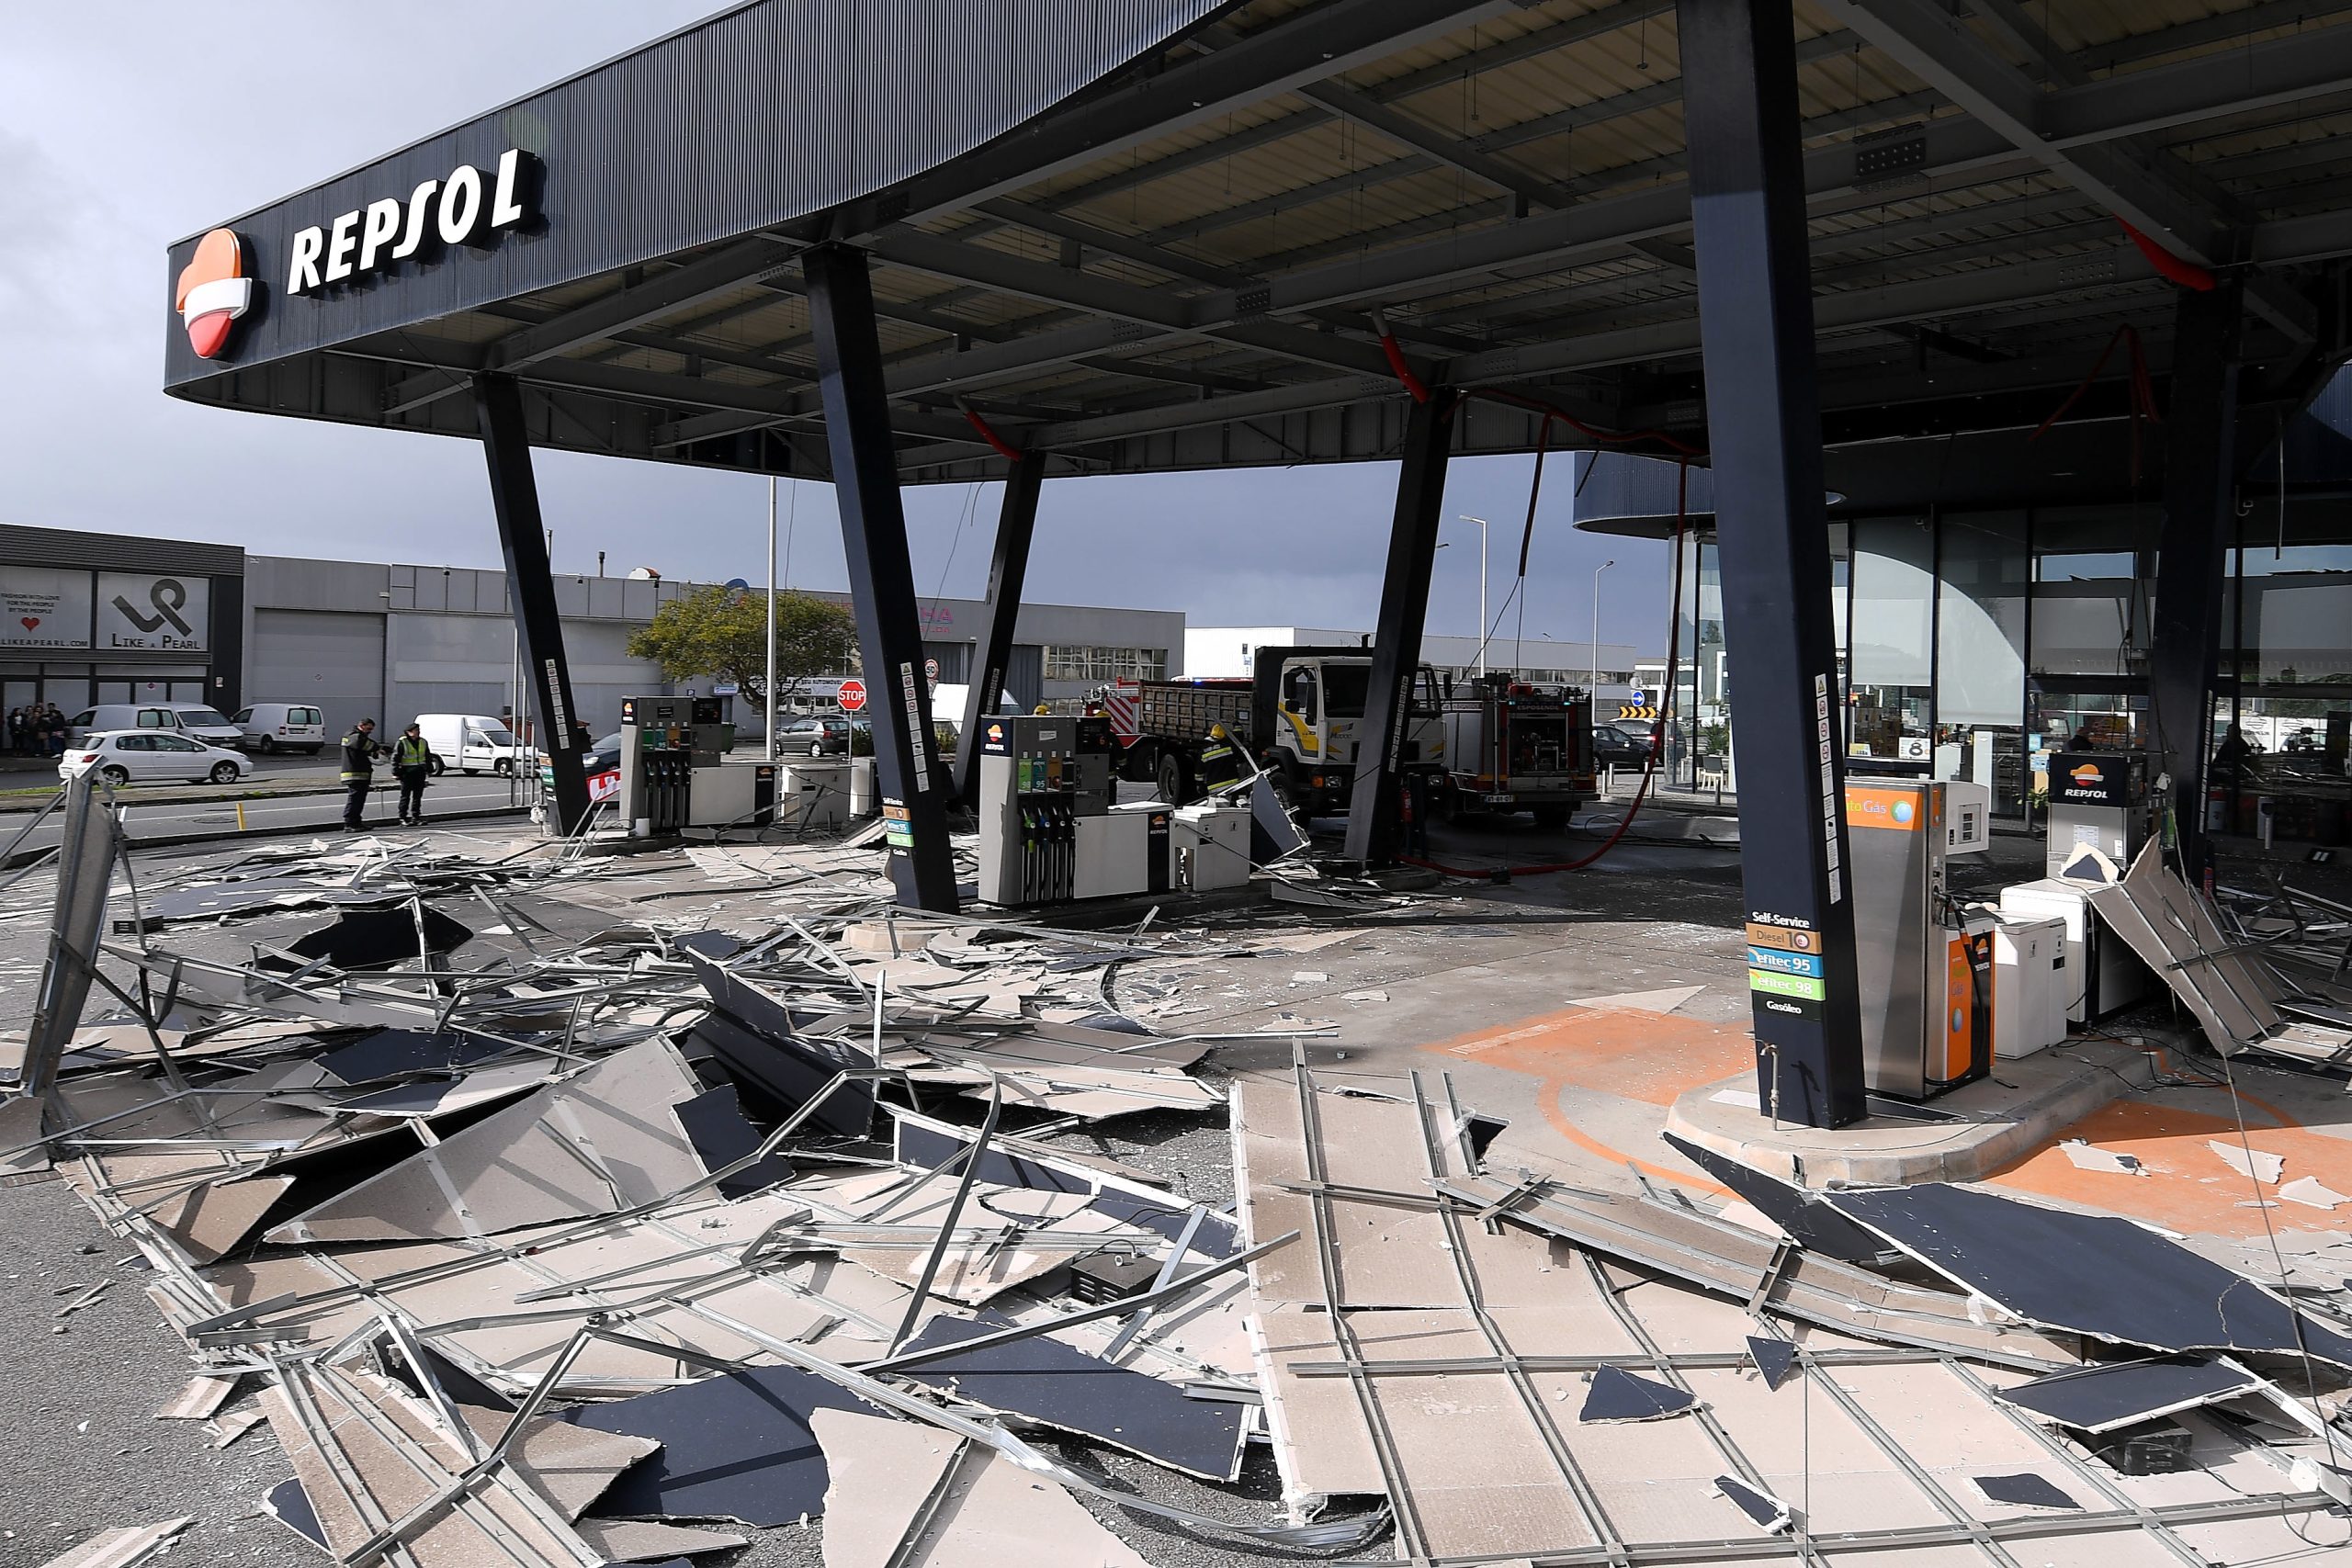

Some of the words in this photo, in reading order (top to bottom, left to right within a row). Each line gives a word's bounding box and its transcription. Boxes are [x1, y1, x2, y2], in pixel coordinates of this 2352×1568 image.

[287, 148, 523, 295] REPSOL
[112, 633, 144, 648] LIKE
[163, 635, 200, 649] PEARL
[839, 690, 865, 701] STOP
[1035, 780, 1046, 788] 95
[2064, 788, 2109, 798] REPSOL
[1752, 911, 1810, 929] Self-Service
[1757, 930, 1785, 943] Diesel
[1756, 953, 1792, 967] efitec
[1792, 957, 1811, 971] 95
[1758, 976, 1792, 990] efitec
[1795, 981, 1813, 994] 98
[1766, 1000, 1803, 1014] Gasóleo
